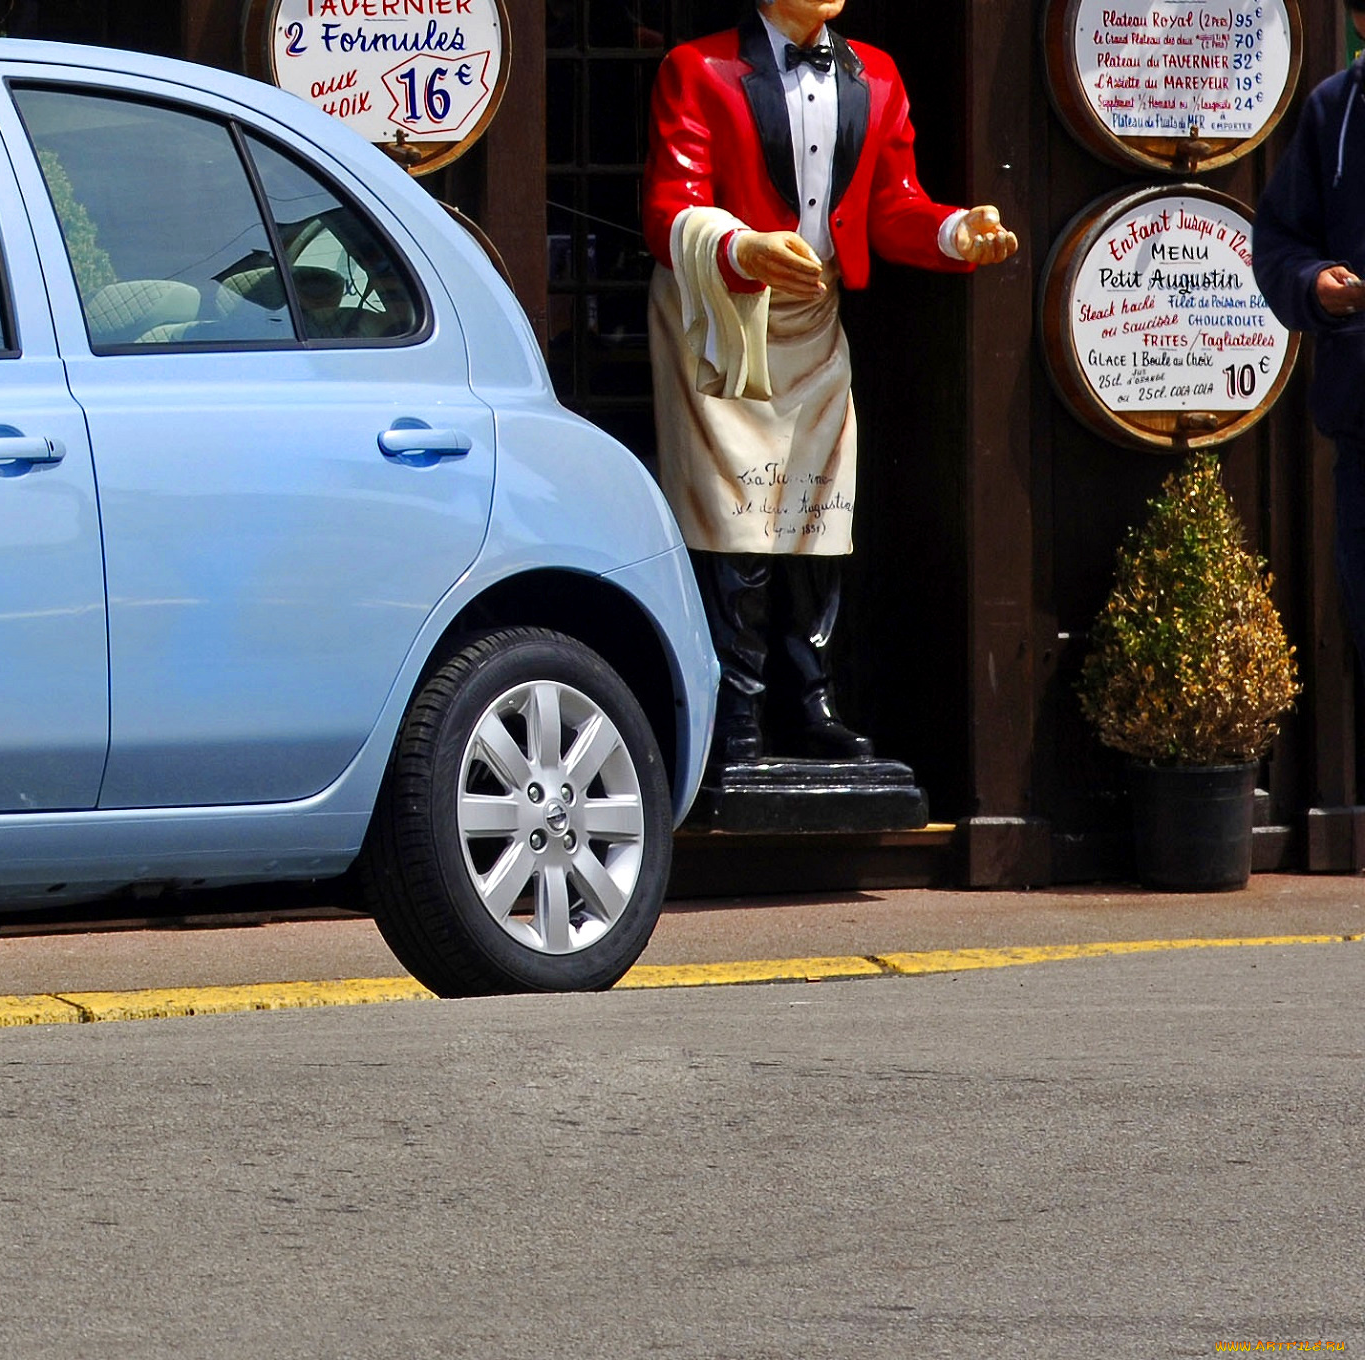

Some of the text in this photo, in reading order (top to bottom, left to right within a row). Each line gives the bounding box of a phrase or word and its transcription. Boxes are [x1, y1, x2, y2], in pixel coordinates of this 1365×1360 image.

[1102, 10, 1147, 28] Plateau
[284, 19, 467, 58] 2 Formules
[1131, 32, 1161, 45] Plateau
[1163, 33, 1175, 45] des
[1097, 52, 1140, 68] Plateau
[1147, 55, 1160, 68] du
[1162, 55, 1229, 69] TAVERNIER
[310, 69, 359, 98] aux
[1145, 76, 1158, 89] du
[1164, 76, 1229, 90] MAREYEUR
[1112, 112, 1144, 129] Plateau
[1155, 113, 1177, 129] Fruits
[1210, 121, 1253, 131] EMPORTER
[1228, 228, 1248, 253] 12
[1151, 242, 1209, 261] MENU
[1099, 268, 1243, 295] Petit Augustin
[1078, 295, 1156, 323] Steack haché
[1167, 294, 1269, 309] Filet de Poisson Bla
[1188, 314, 1265, 327] CHOUCROUTE
[1101, 326, 1118, 339] ou
[1200, 330, 1275, 352] Tagliatelles
[1088, 349, 1127, 367] GLACE
[1141, 351, 1170, 367] Boule
[1186, 351, 1214, 367] Choix
